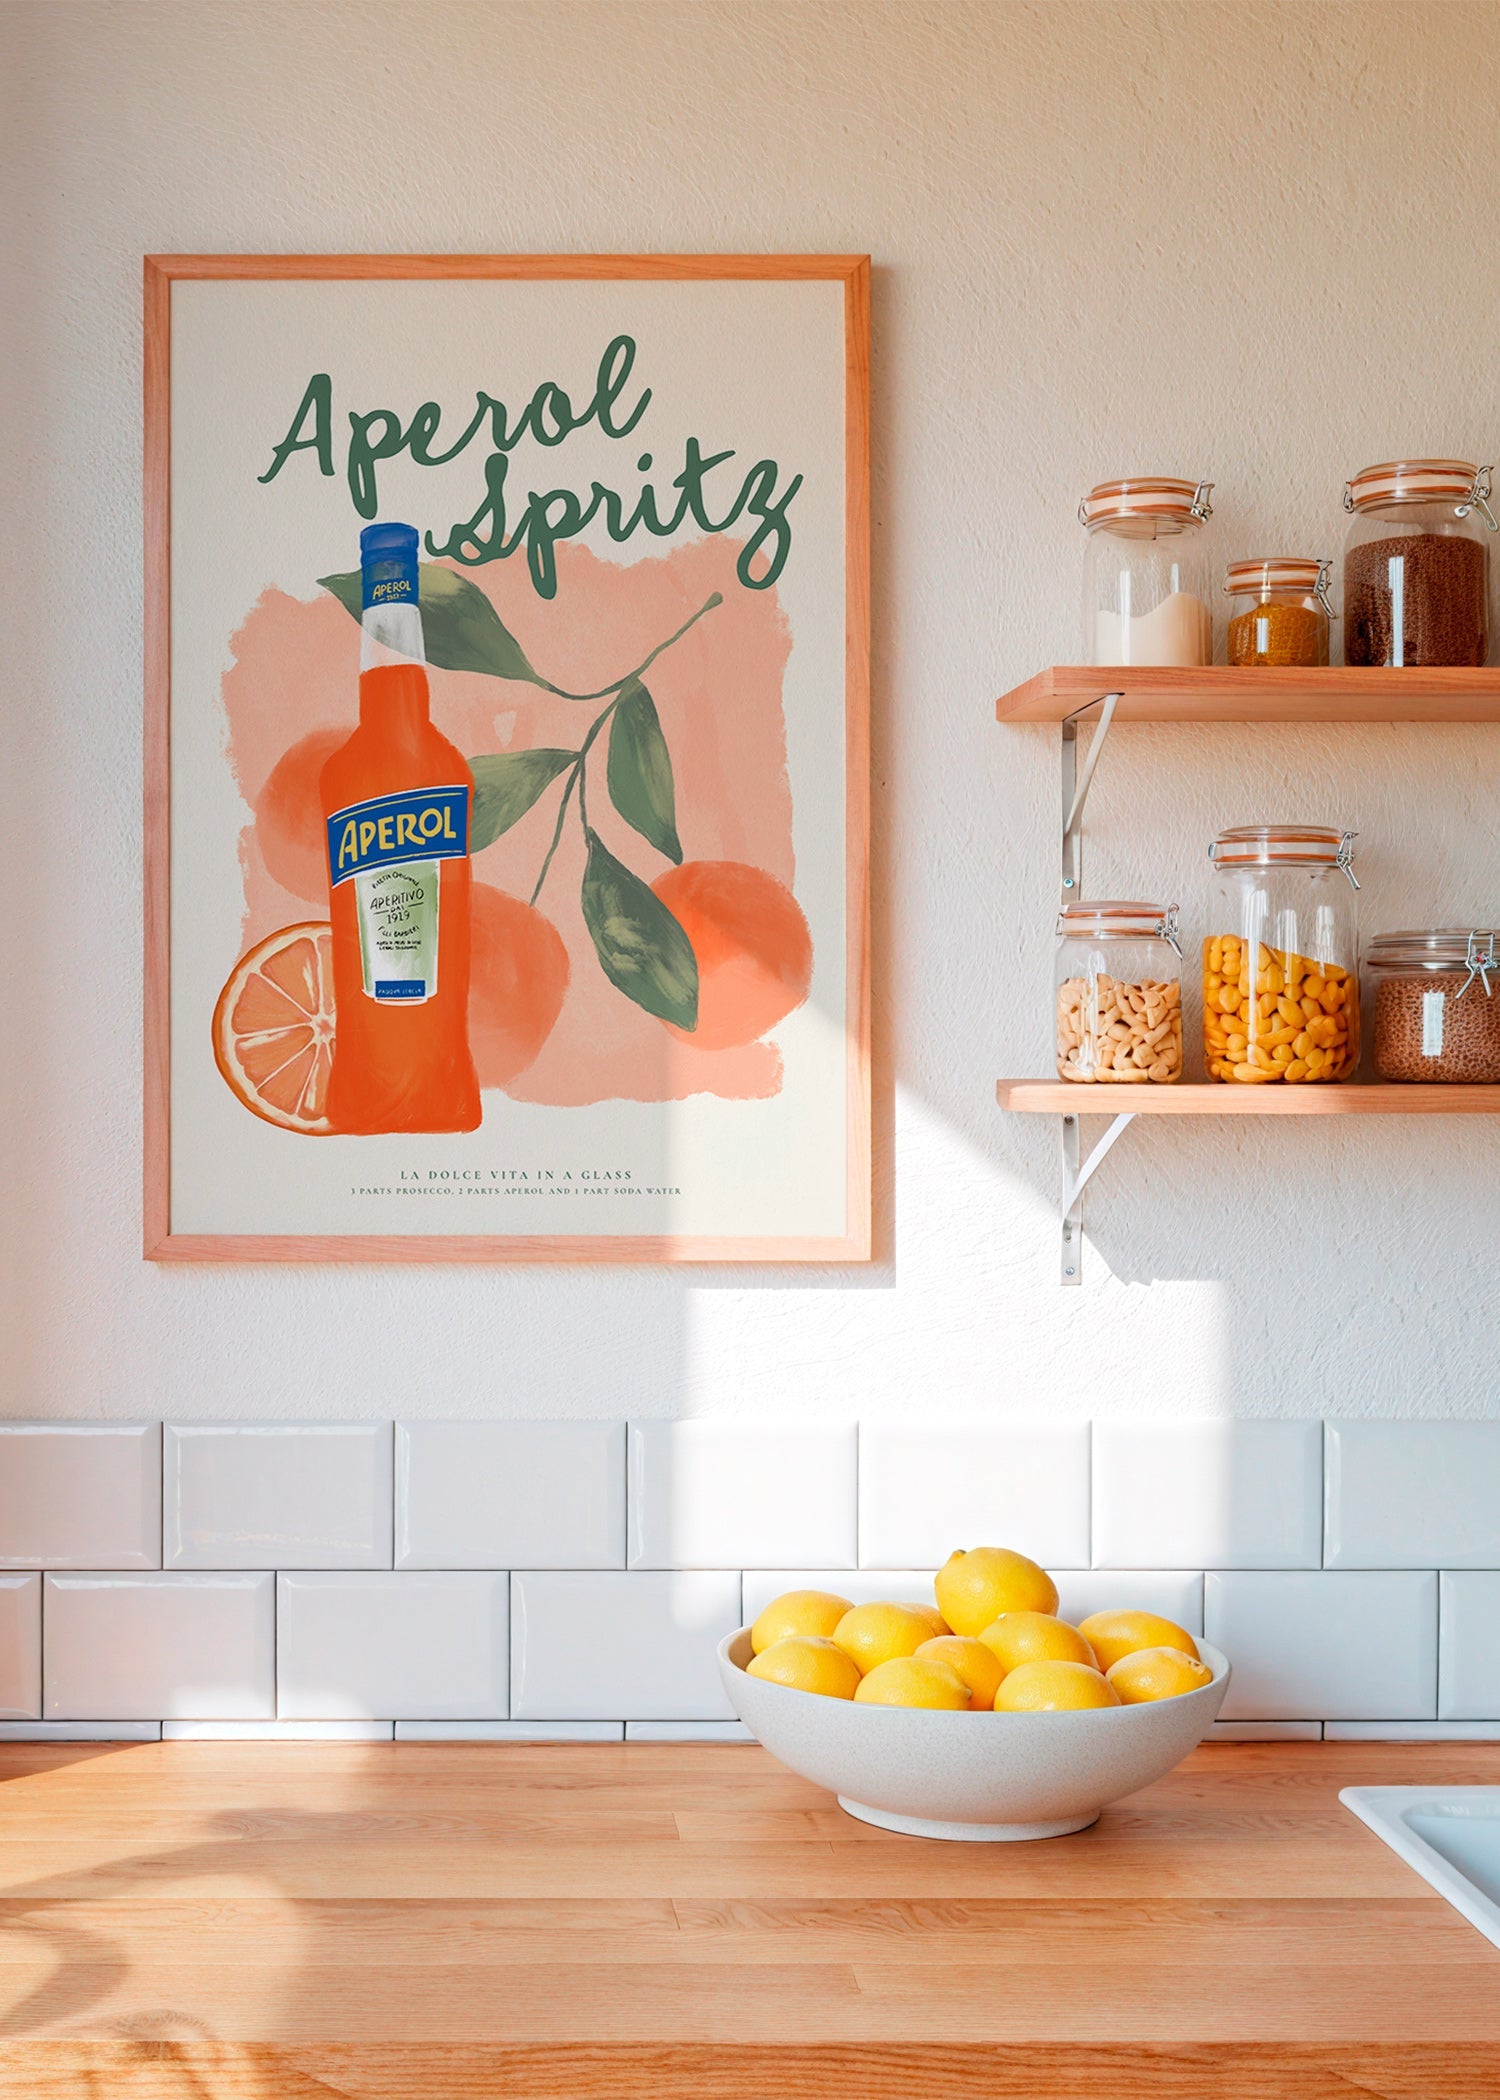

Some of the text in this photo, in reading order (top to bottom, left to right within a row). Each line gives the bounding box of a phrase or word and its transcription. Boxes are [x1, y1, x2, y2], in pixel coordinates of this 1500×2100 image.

[257, 335, 652, 520] Aperol
[425, 437, 804, 599] Spritz
[372, 580, 412, 600] APEROL
[338, 805, 457, 869] APEROL
[370, 888, 424, 910] APERITIVO
[387, 910, 411, 924] 1919
[399, 1170, 632, 1181] LA DOLCE VITA IN A GLASS
[351, 1187, 356, 1196] 3
[359, 1187, 392, 1196] PARTS
[396, 1187, 455, 1197] PROSECCO,
[458, 1187, 464, 1196] 2
[467, 1187, 500, 1196] PARTS
[504, 1187, 545, 1196] APEROL
[549, 1187, 571, 1196] AND
[583, 1187, 610, 1196] PART
[613, 1187, 642, 1196] SODA
[645, 1187, 682, 1196] WATER
